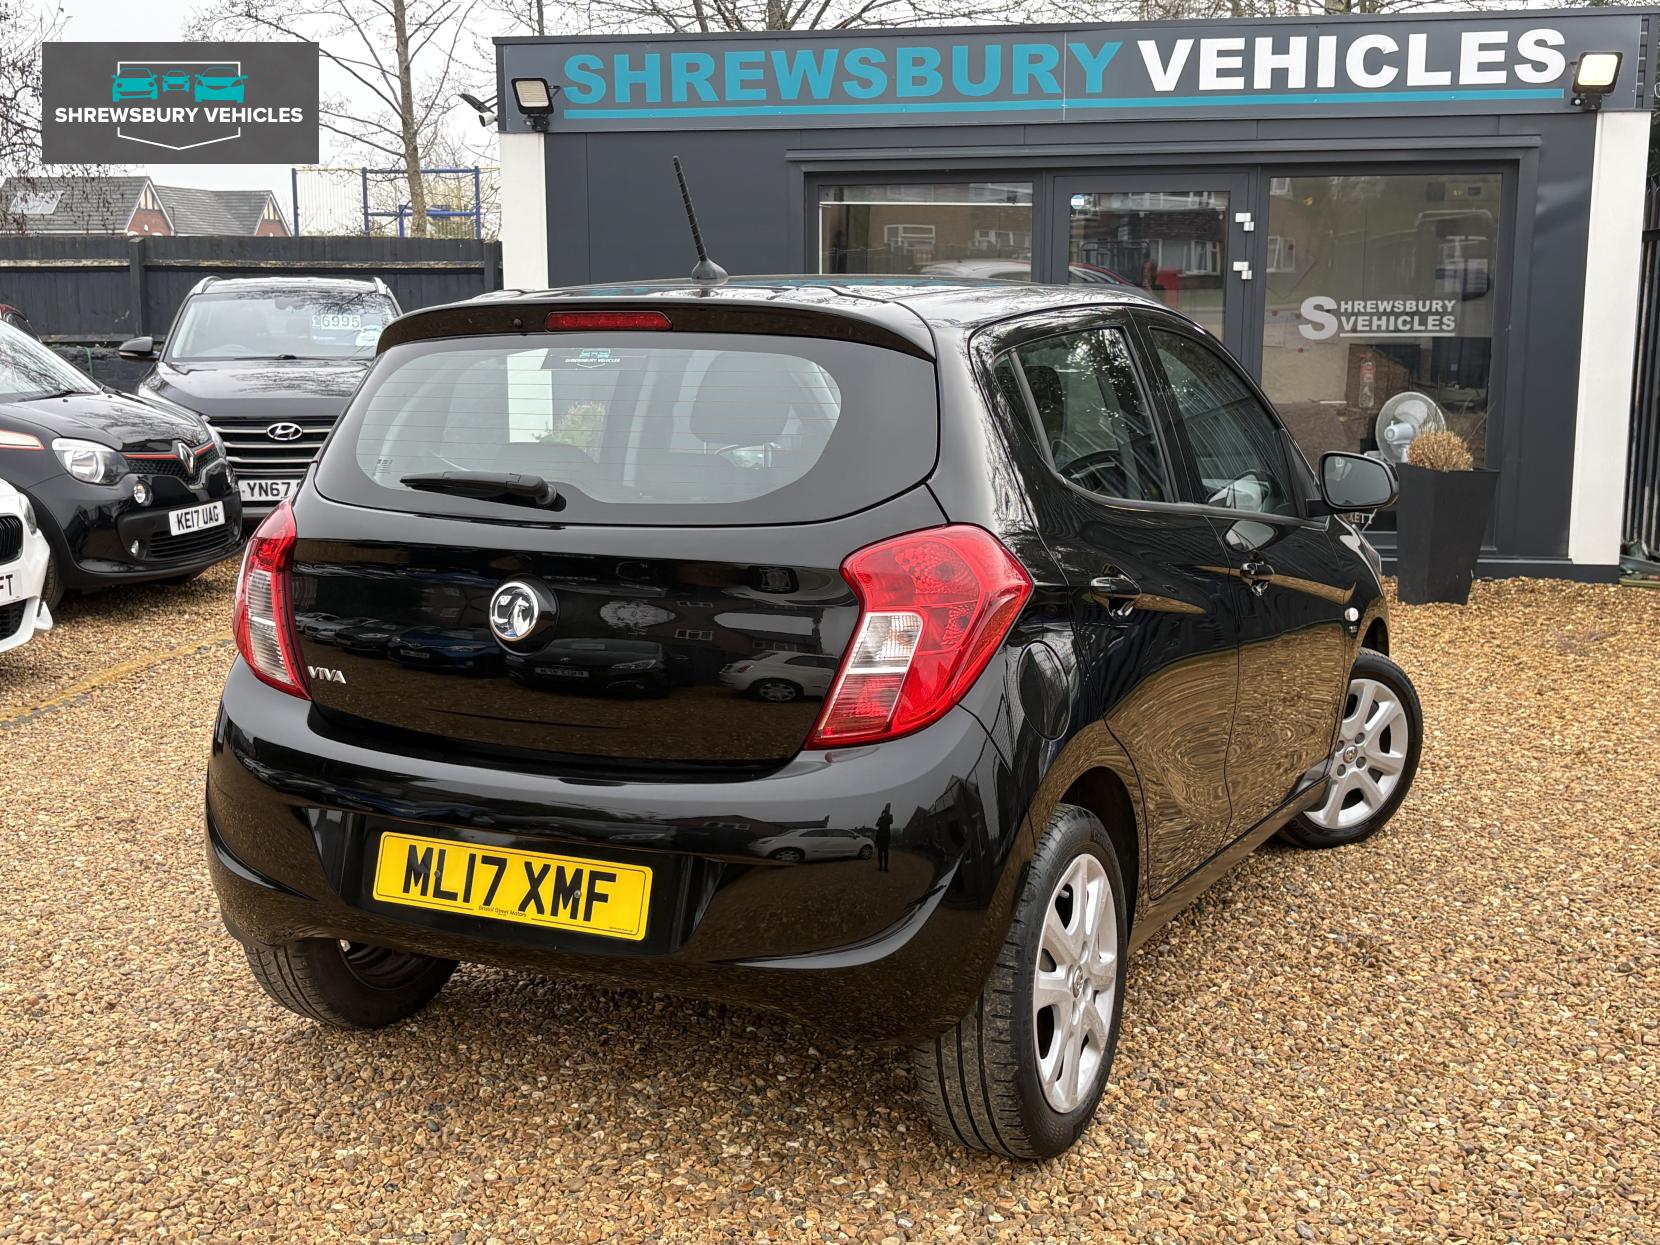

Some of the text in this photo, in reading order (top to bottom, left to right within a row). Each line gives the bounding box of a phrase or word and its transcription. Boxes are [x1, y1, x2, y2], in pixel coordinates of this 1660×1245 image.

[564, 28, 1566, 105] SHREWSBURY VEHICLES
[1340, 315, 1457, 332] VEHICLES
[246, 482, 291, 497] YN67
[176, 505, 219, 531] KE17 UAG
[307, 665, 346, 685] VIVA
[402, 844, 617, 922] ML17 XMF
